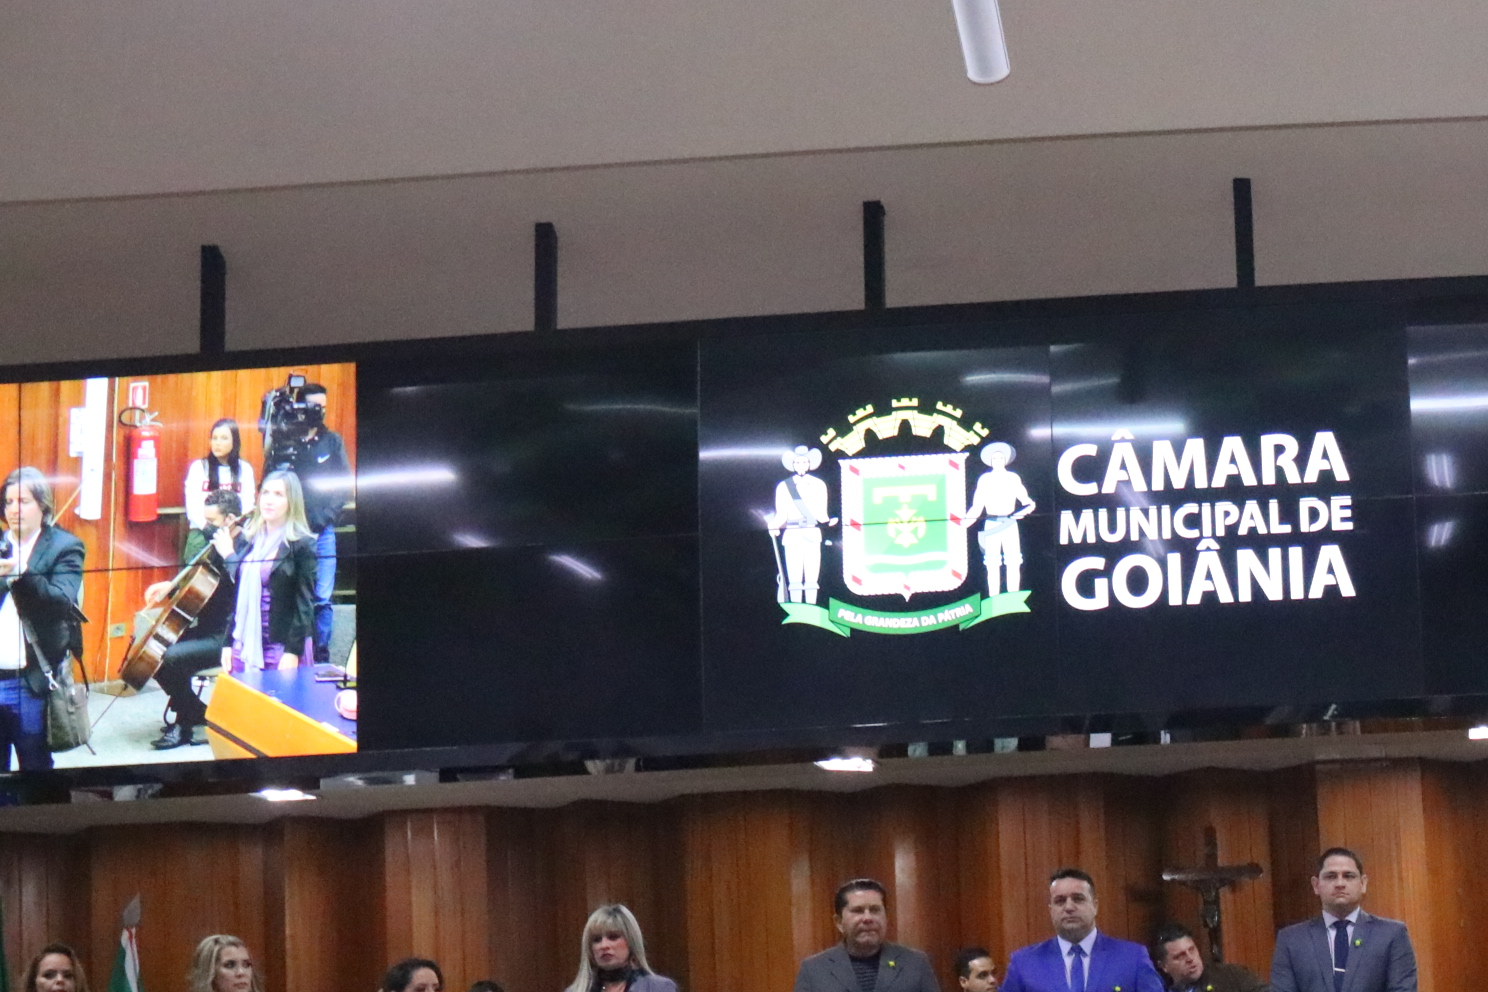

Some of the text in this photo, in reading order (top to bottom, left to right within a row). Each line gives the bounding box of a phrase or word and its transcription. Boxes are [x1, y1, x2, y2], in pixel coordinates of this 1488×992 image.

[1057, 428, 1350, 496] CÂMARA
[1059, 495, 1354, 545] MUNICIPAL DE
[1061, 538, 1356, 611] GOIÂNIA
[837, 603, 974, 628] PELA GRANDEZA DA PÁTRIA
